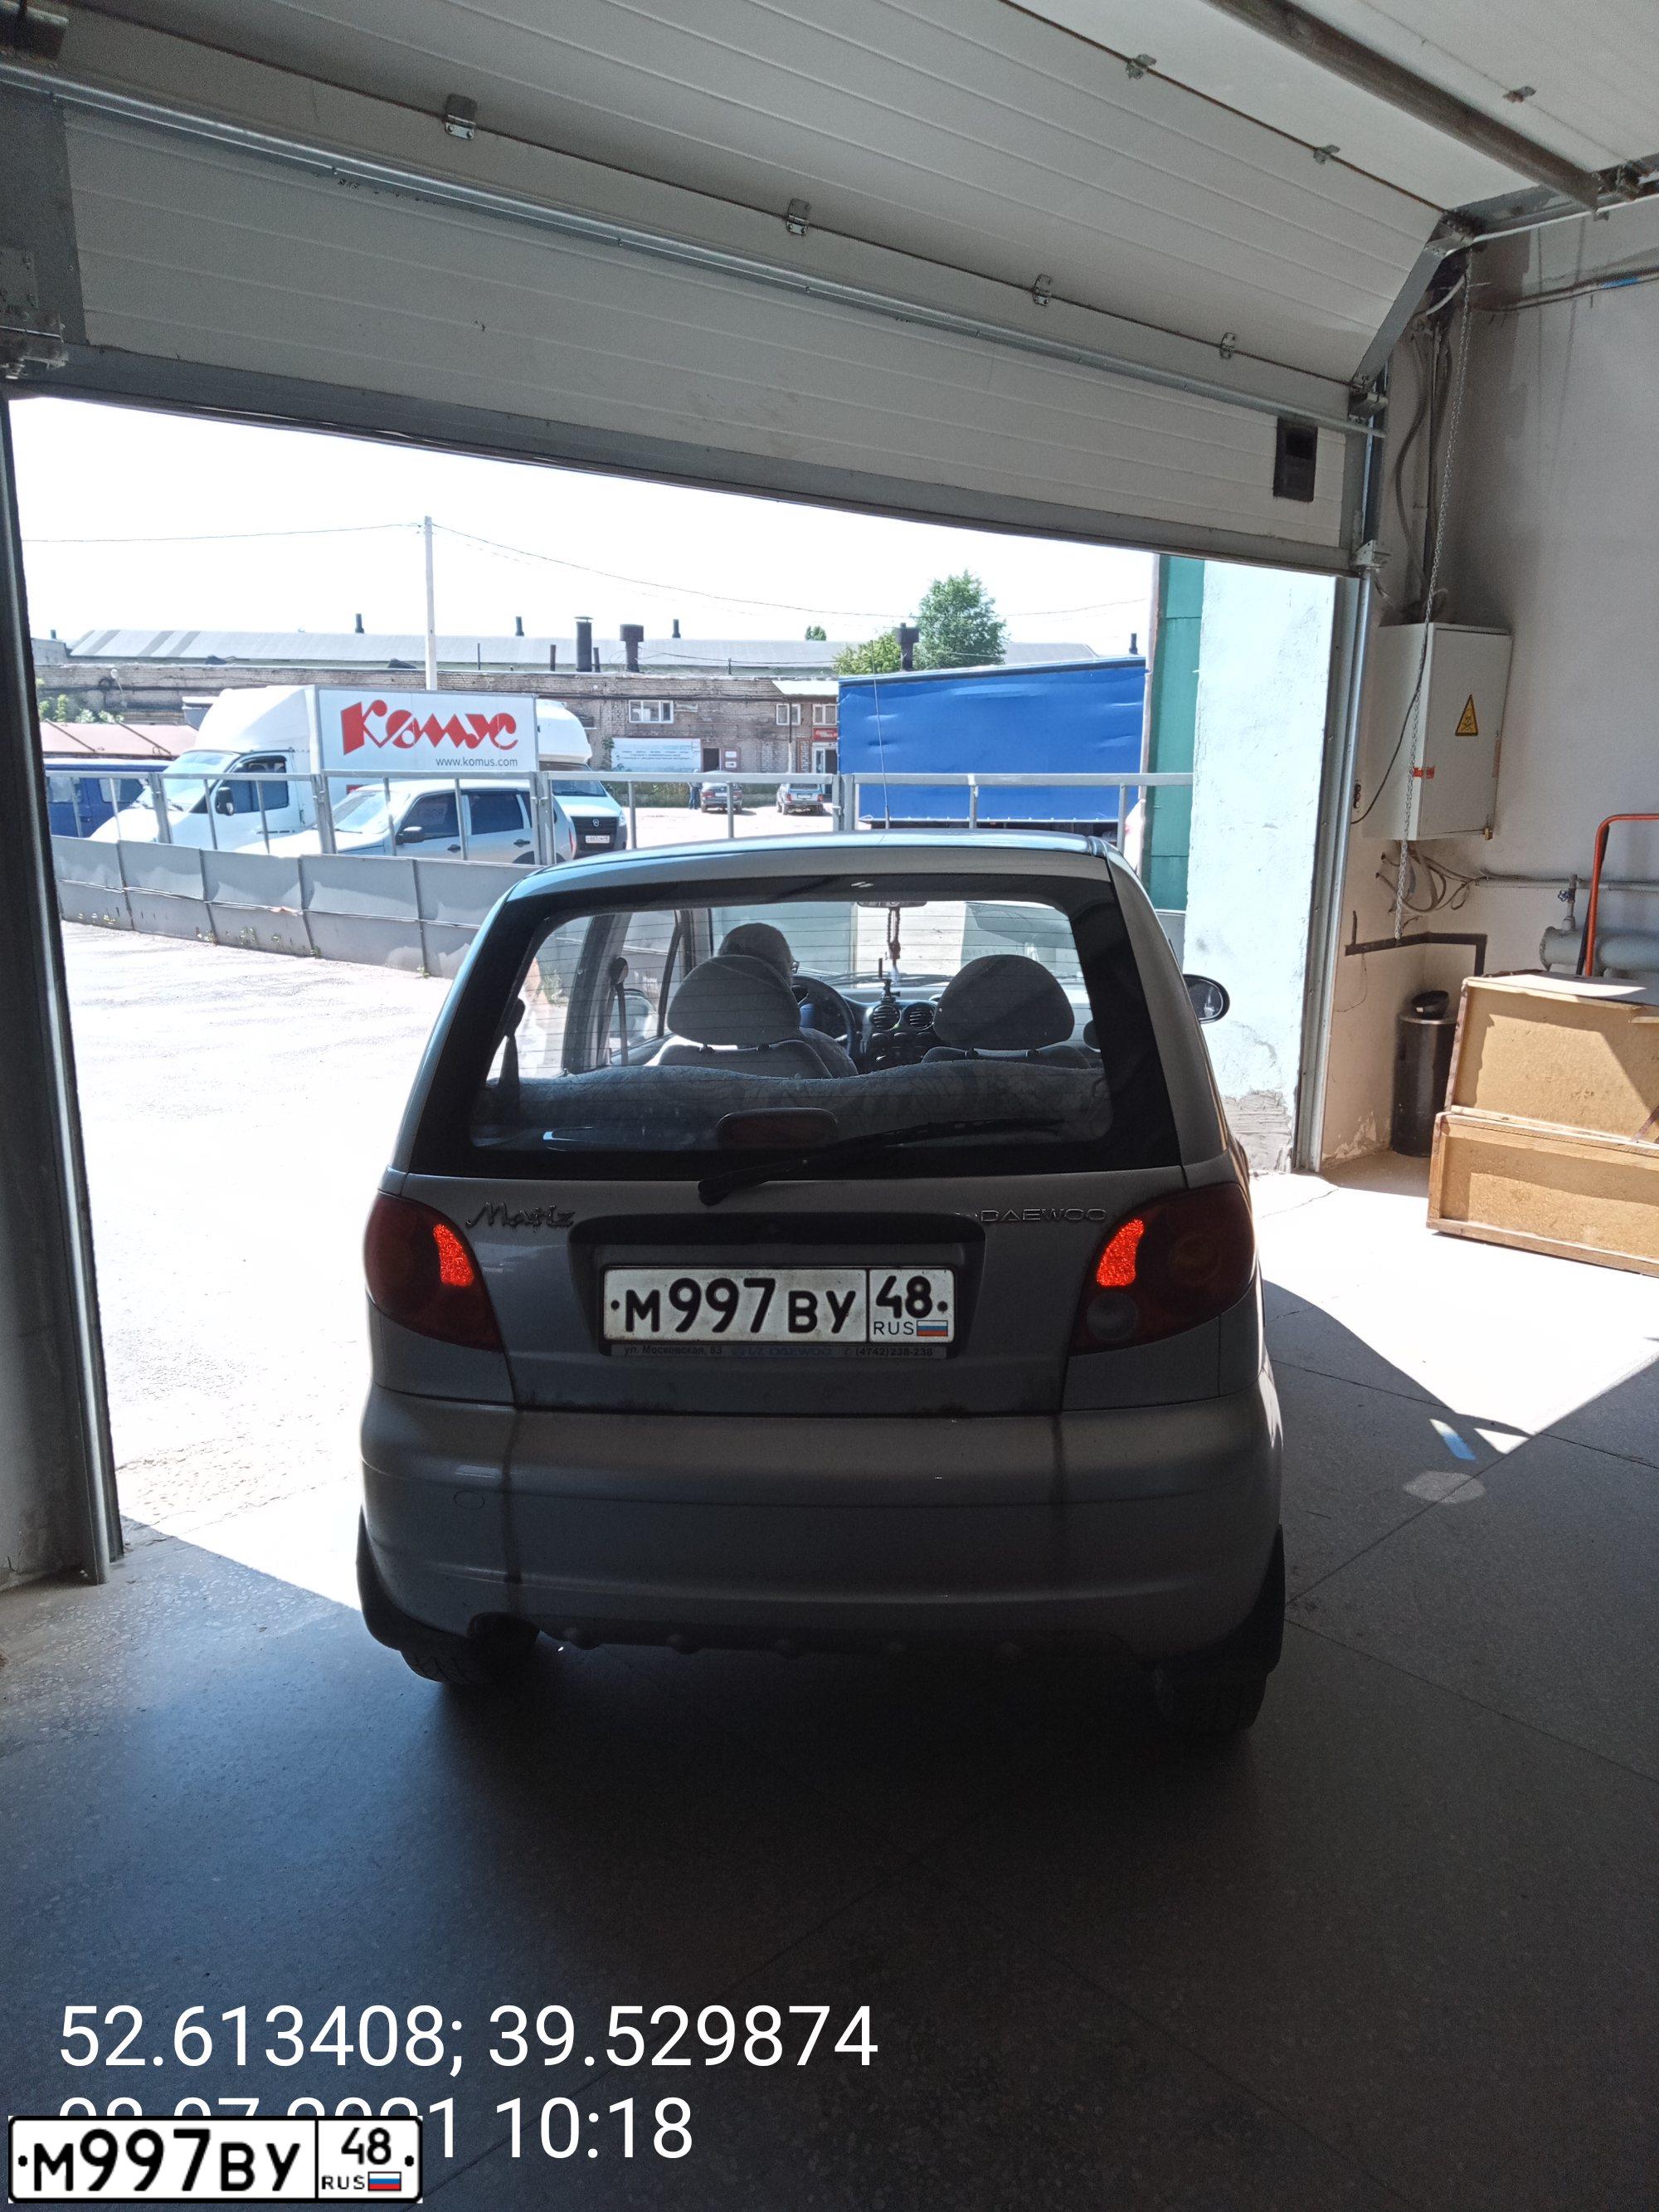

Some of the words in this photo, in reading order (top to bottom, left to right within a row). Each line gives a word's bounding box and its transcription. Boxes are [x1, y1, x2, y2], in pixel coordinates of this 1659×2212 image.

[340, 699, 518, 756] Комус
[435, 757, 518, 767] www.komus.com
[980, 1208, 1107, 1222] DAEWOO
[874, 1275, 932, 1319] 48
[873, 1321, 915, 1336] RUS
